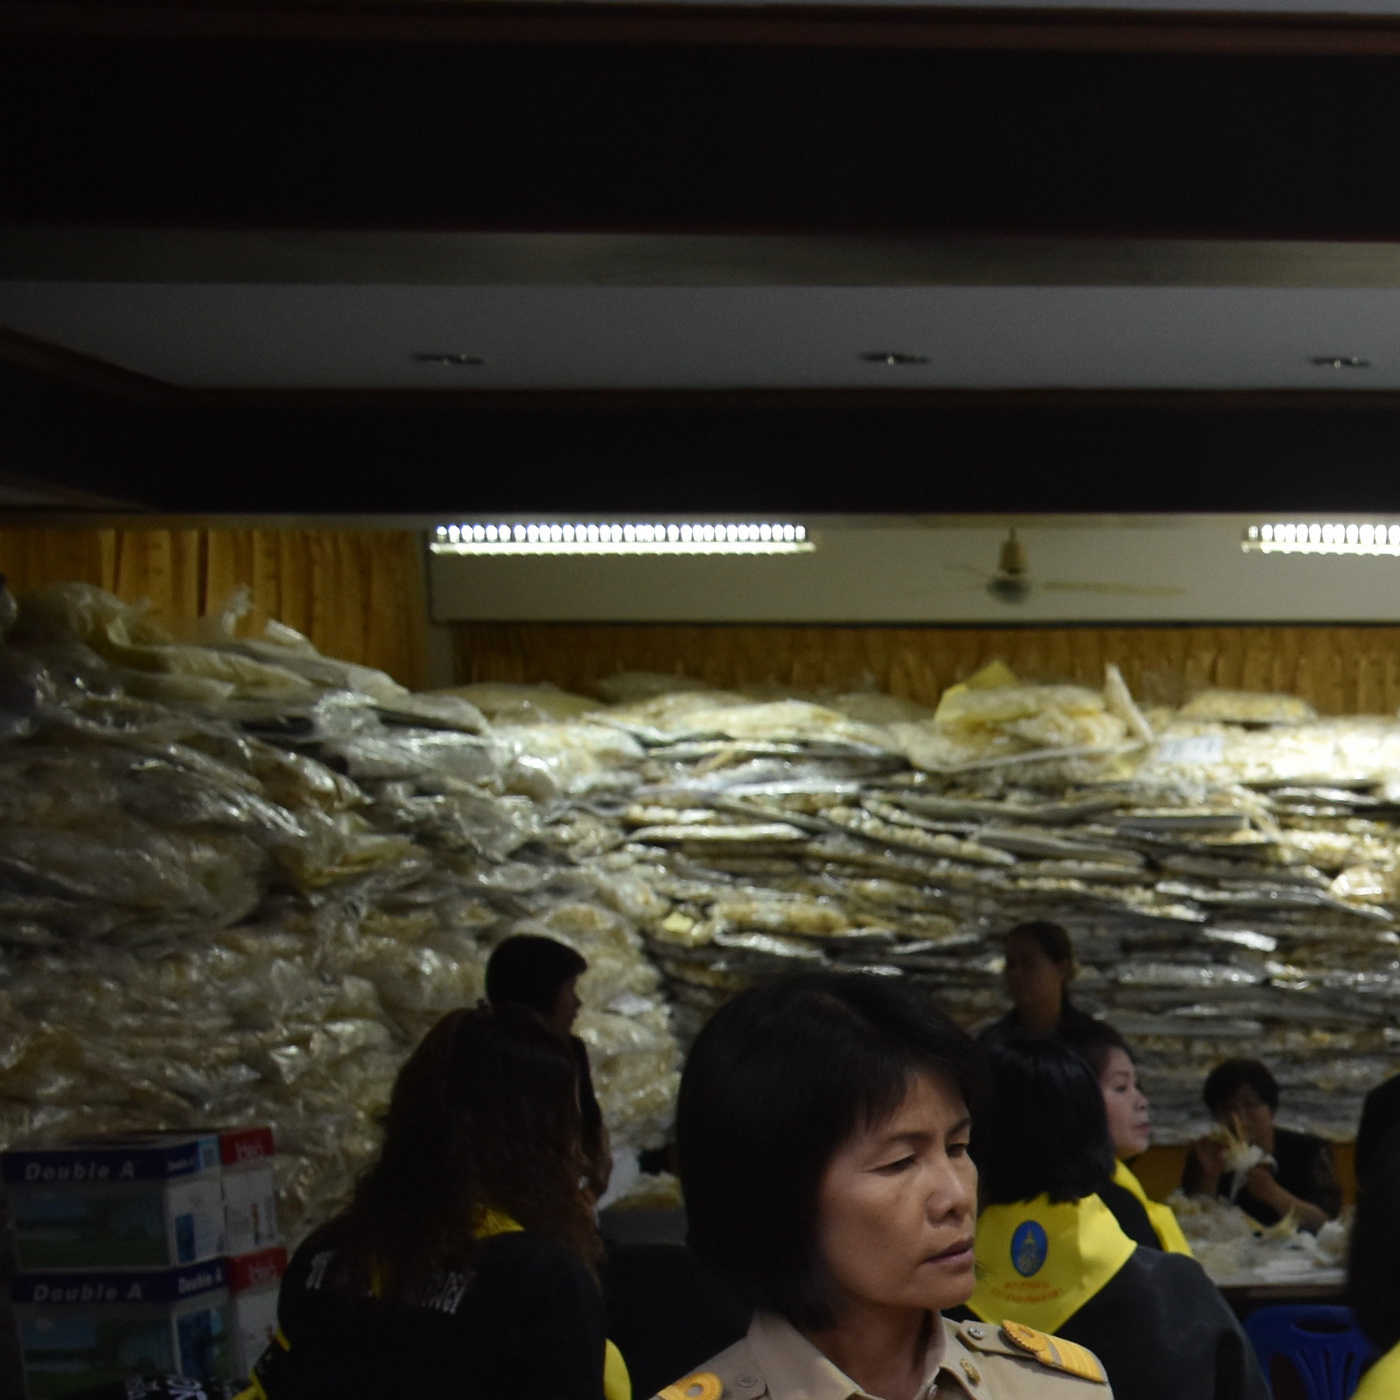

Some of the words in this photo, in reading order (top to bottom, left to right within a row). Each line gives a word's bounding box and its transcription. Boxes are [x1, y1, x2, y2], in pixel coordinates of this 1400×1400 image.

[24, 1160, 110, 1182] Double
[119, 1160, 135, 1179] A
[33, 1282, 118, 1303] Double
[126, 1281, 143, 1301] A
